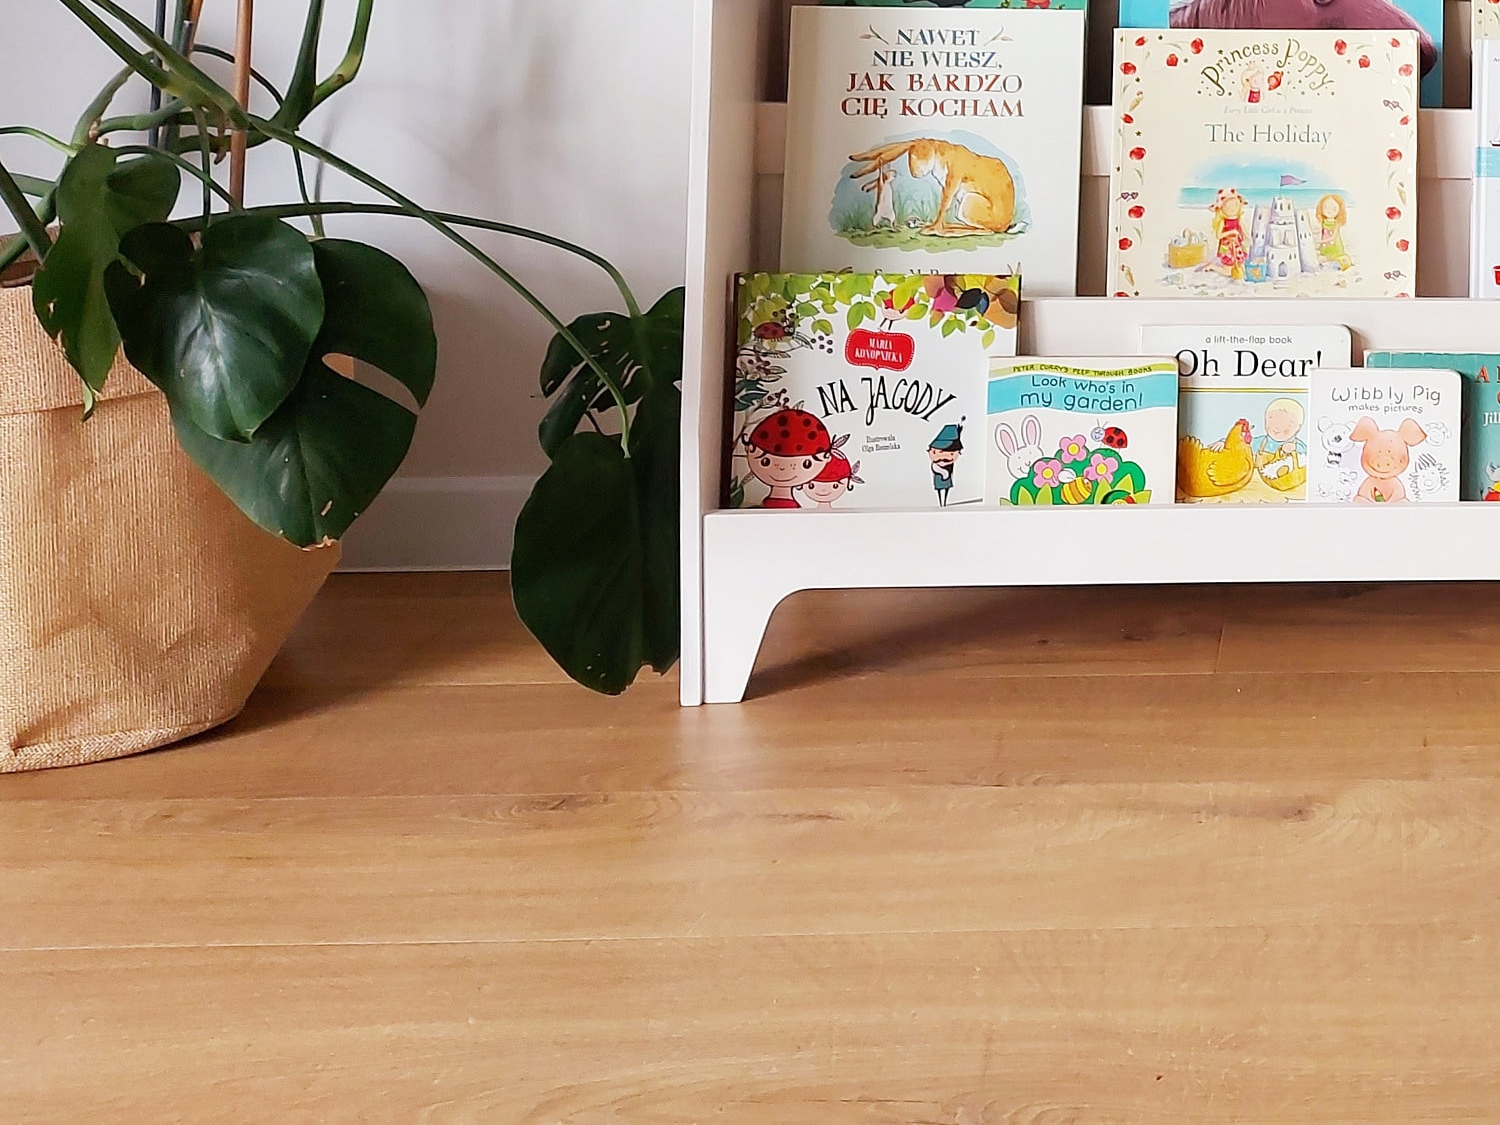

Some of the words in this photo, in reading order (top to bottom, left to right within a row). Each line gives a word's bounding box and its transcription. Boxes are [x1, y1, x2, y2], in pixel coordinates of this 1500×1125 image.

[895, 27, 982, 46] NAWET
[870, 50, 914, 68] NIE
[1200, 42, 1279, 97] Princess
[1276, 38, 1335, 91] Poppy
[846, 73, 896, 93] JAK
[906, 73, 1023, 93] BARDZO
[840, 97, 888, 119] CIĘ
[898, 98, 1025, 117] KOCHAM
[1204, 123, 1245, 143] The
[1253, 123, 1332, 150] Holiday
[1205, 336, 1211, 344] a
[1213, 335, 1266, 345] lift-the-flap
[1269, 335, 1293, 344] book
[1012, 364, 1036, 373] PETER
[1128, 366, 1153, 375] BOOKS
[1175, 349, 1219, 377] Oh
[1233, 349, 1323, 378] Dear!
[1475, 364, 1490, 384] A
[1031, 375, 1067, 388] Look
[1074, 380, 1116, 394] who's
[1121, 381, 1135, 393] in
[816, 378, 858, 419] NA
[861, 375, 958, 427] JAGODY
[1020, 391, 1053, 406] my
[1064, 393, 1143, 411] garden!
[1331, 386, 1404, 405] Wibbly
[1413, 385, 1441, 406] Pig
[1348, 403, 1380, 412] makes
[1383, 403, 1424, 414] pictures
